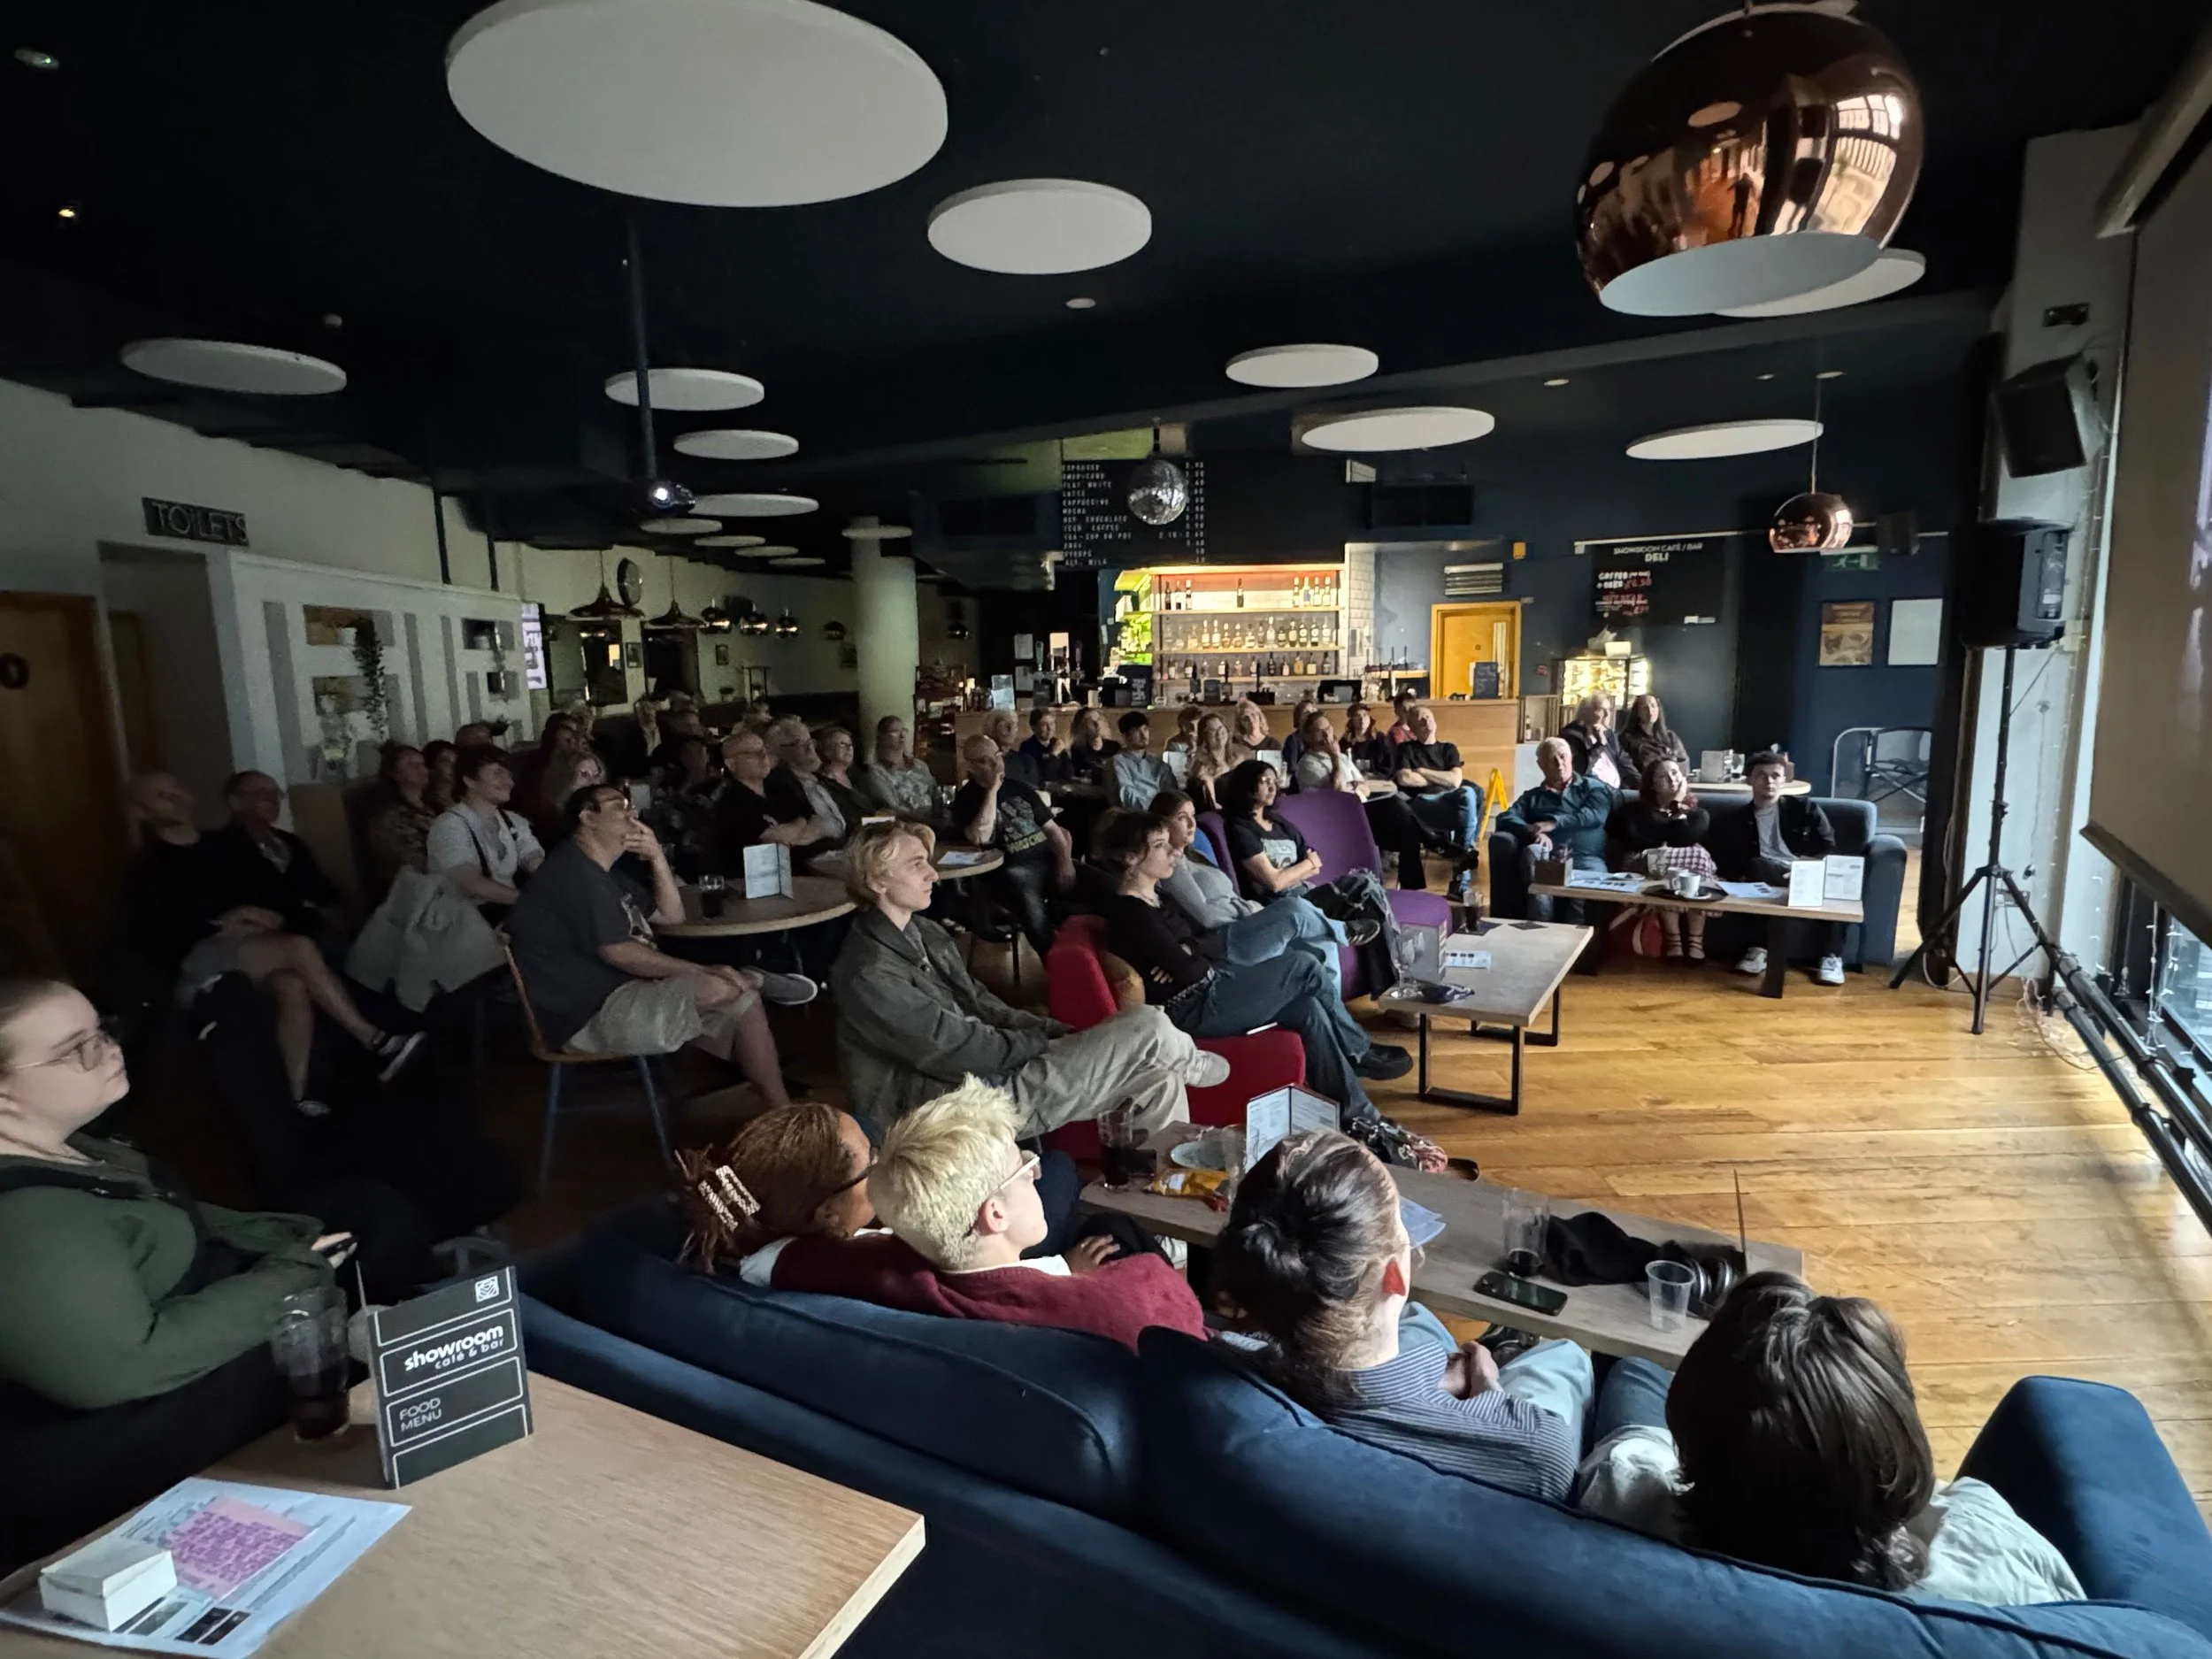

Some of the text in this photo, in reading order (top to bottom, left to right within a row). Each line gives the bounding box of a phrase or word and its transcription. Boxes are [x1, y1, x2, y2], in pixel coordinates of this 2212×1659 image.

[151, 502, 248, 542] TOILETS
[1645, 552, 1669, 563] DELI
[1686, 541, 1703, 550] BAR
[403, 1325, 503, 1371] showroom
[434, 1337, 504, 1370] café & bar
[399, 1396, 442, 1420] FOOD
[400, 1409, 442, 1432] MENU
